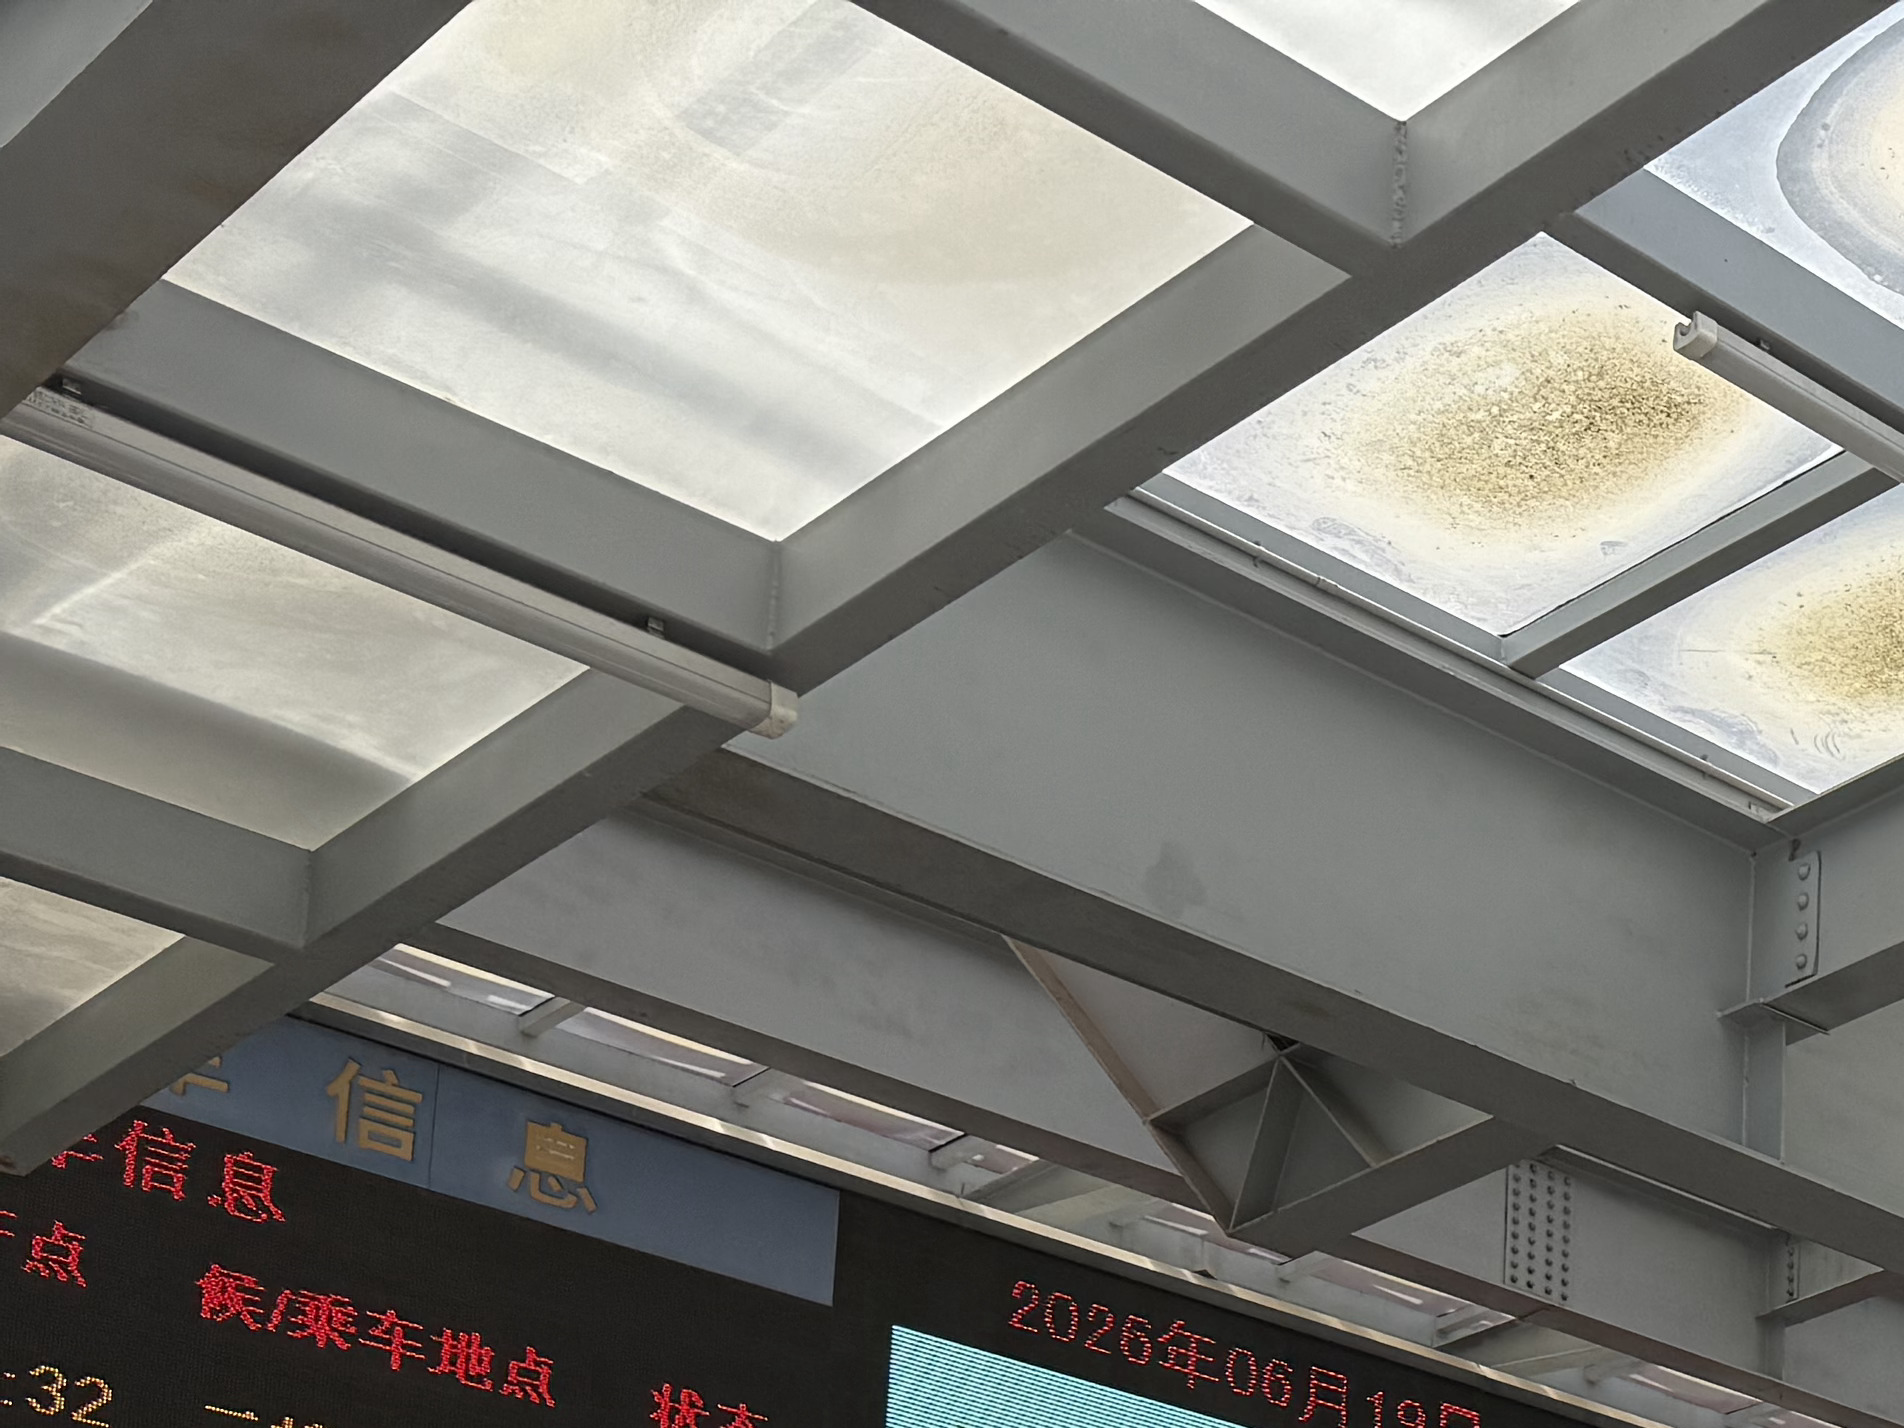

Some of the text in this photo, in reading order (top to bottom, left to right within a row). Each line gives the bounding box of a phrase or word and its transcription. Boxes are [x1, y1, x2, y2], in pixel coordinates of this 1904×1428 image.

[170, 1056, 597, 1213] 信息
[195, 1263, 556, 1408] 候/乘车地点
